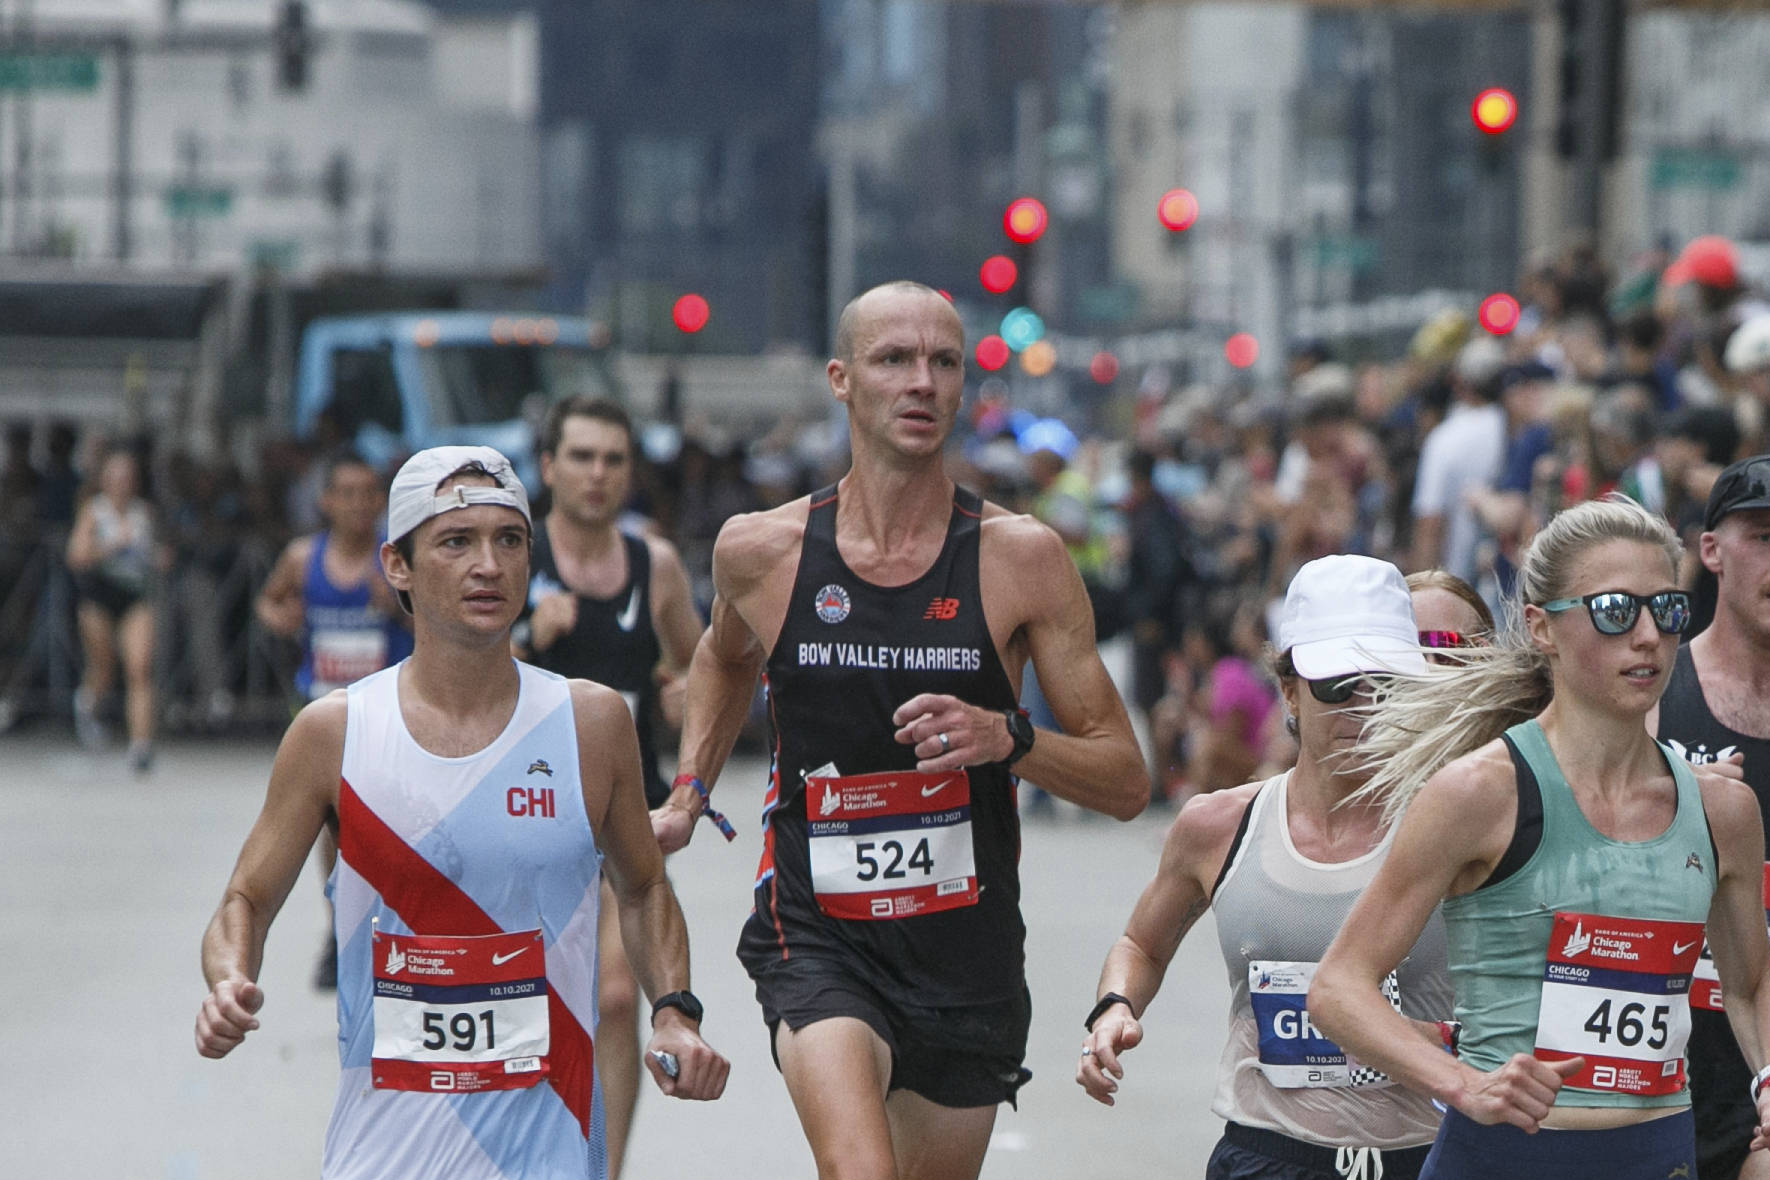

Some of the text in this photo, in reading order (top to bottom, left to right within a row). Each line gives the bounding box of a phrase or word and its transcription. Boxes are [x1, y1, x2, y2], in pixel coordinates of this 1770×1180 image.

[798, 643, 981, 671] BOW VALLEY HARRIERS
[506, 786, 556, 819] CHI
[843, 792, 878, 803] Chicago
[843, 800, 887, 811] Marathon
[812, 822, 849, 831] CHICAGO
[856, 837, 934, 882] 524
[1592, 936, 1632, 951] Chicago
[1590, 946, 1639, 961] Marathon
[407, 955, 445, 968] Chicago
[408, 964, 454, 975] Marathon
[1548, 964, 1590, 978] CHICAGO
[490, 983, 535, 996] 10.10.2021
[422, 1009, 495, 1051] 591
[1584, 998, 1670, 1050] 465
[1306, 1055, 1346, 1064] 10.10.2021
